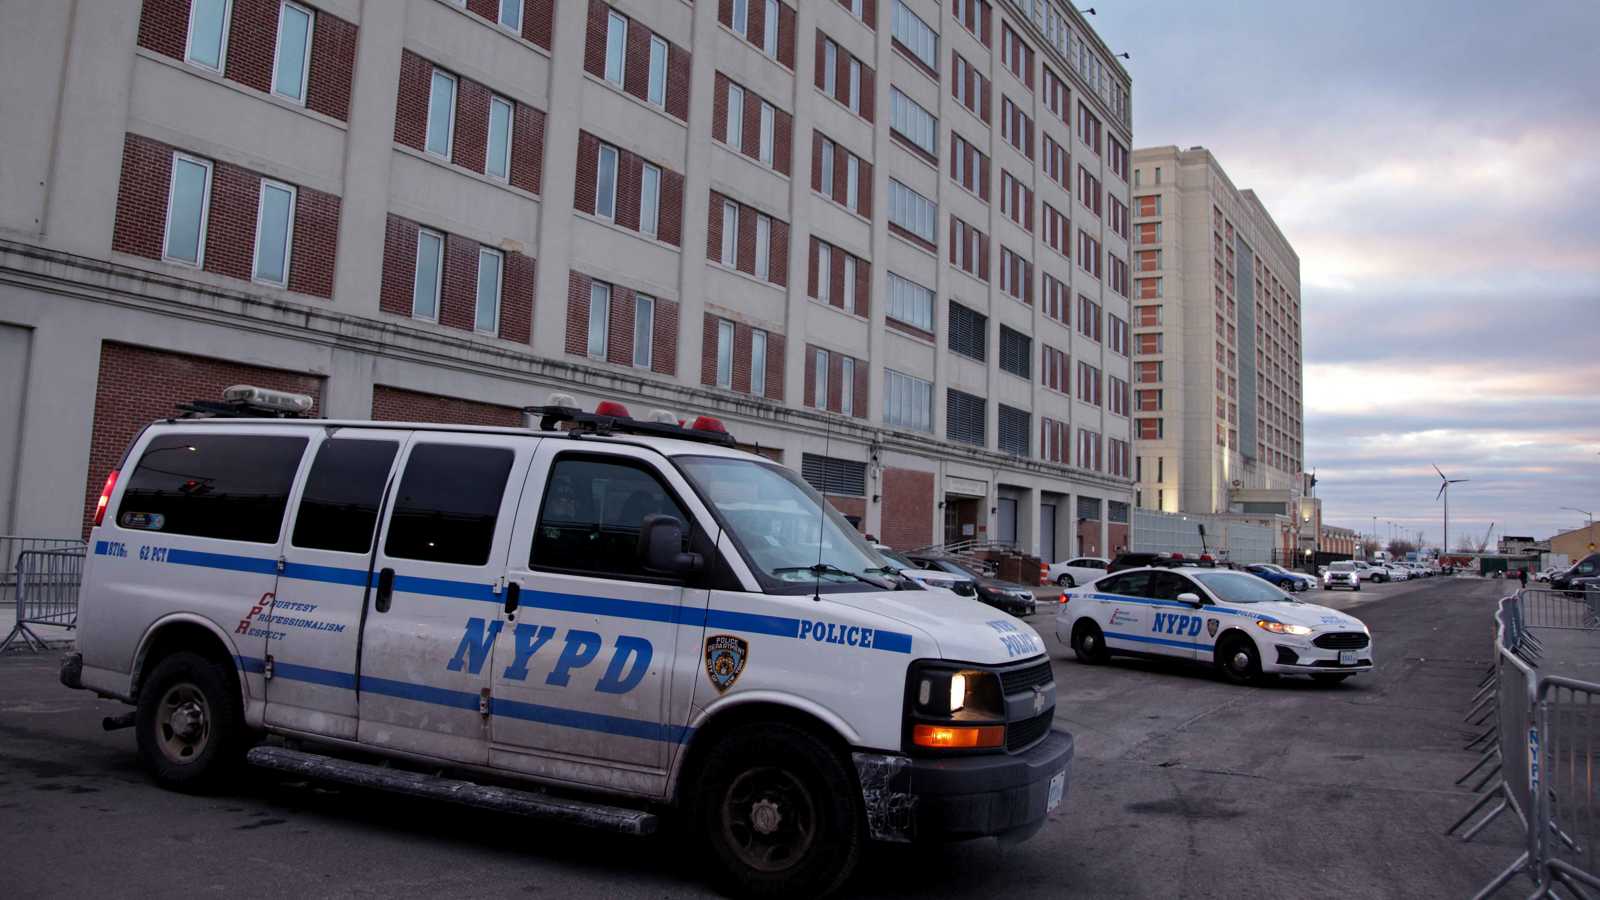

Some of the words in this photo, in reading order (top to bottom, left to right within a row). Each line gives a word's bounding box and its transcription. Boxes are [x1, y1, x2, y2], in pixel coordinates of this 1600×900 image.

[139, 545, 150, 560] 62
[151, 546, 167, 562] PCT
[259, 592, 318, 613] COURTESY
[235, 620, 287, 641] RESPECT
[246, 606, 346, 633] PROFESSIONALISM
[1152, 612, 1203, 637] NYPD
[799, 619, 873, 649] POLICE
[446, 617, 654, 695] NYPD
